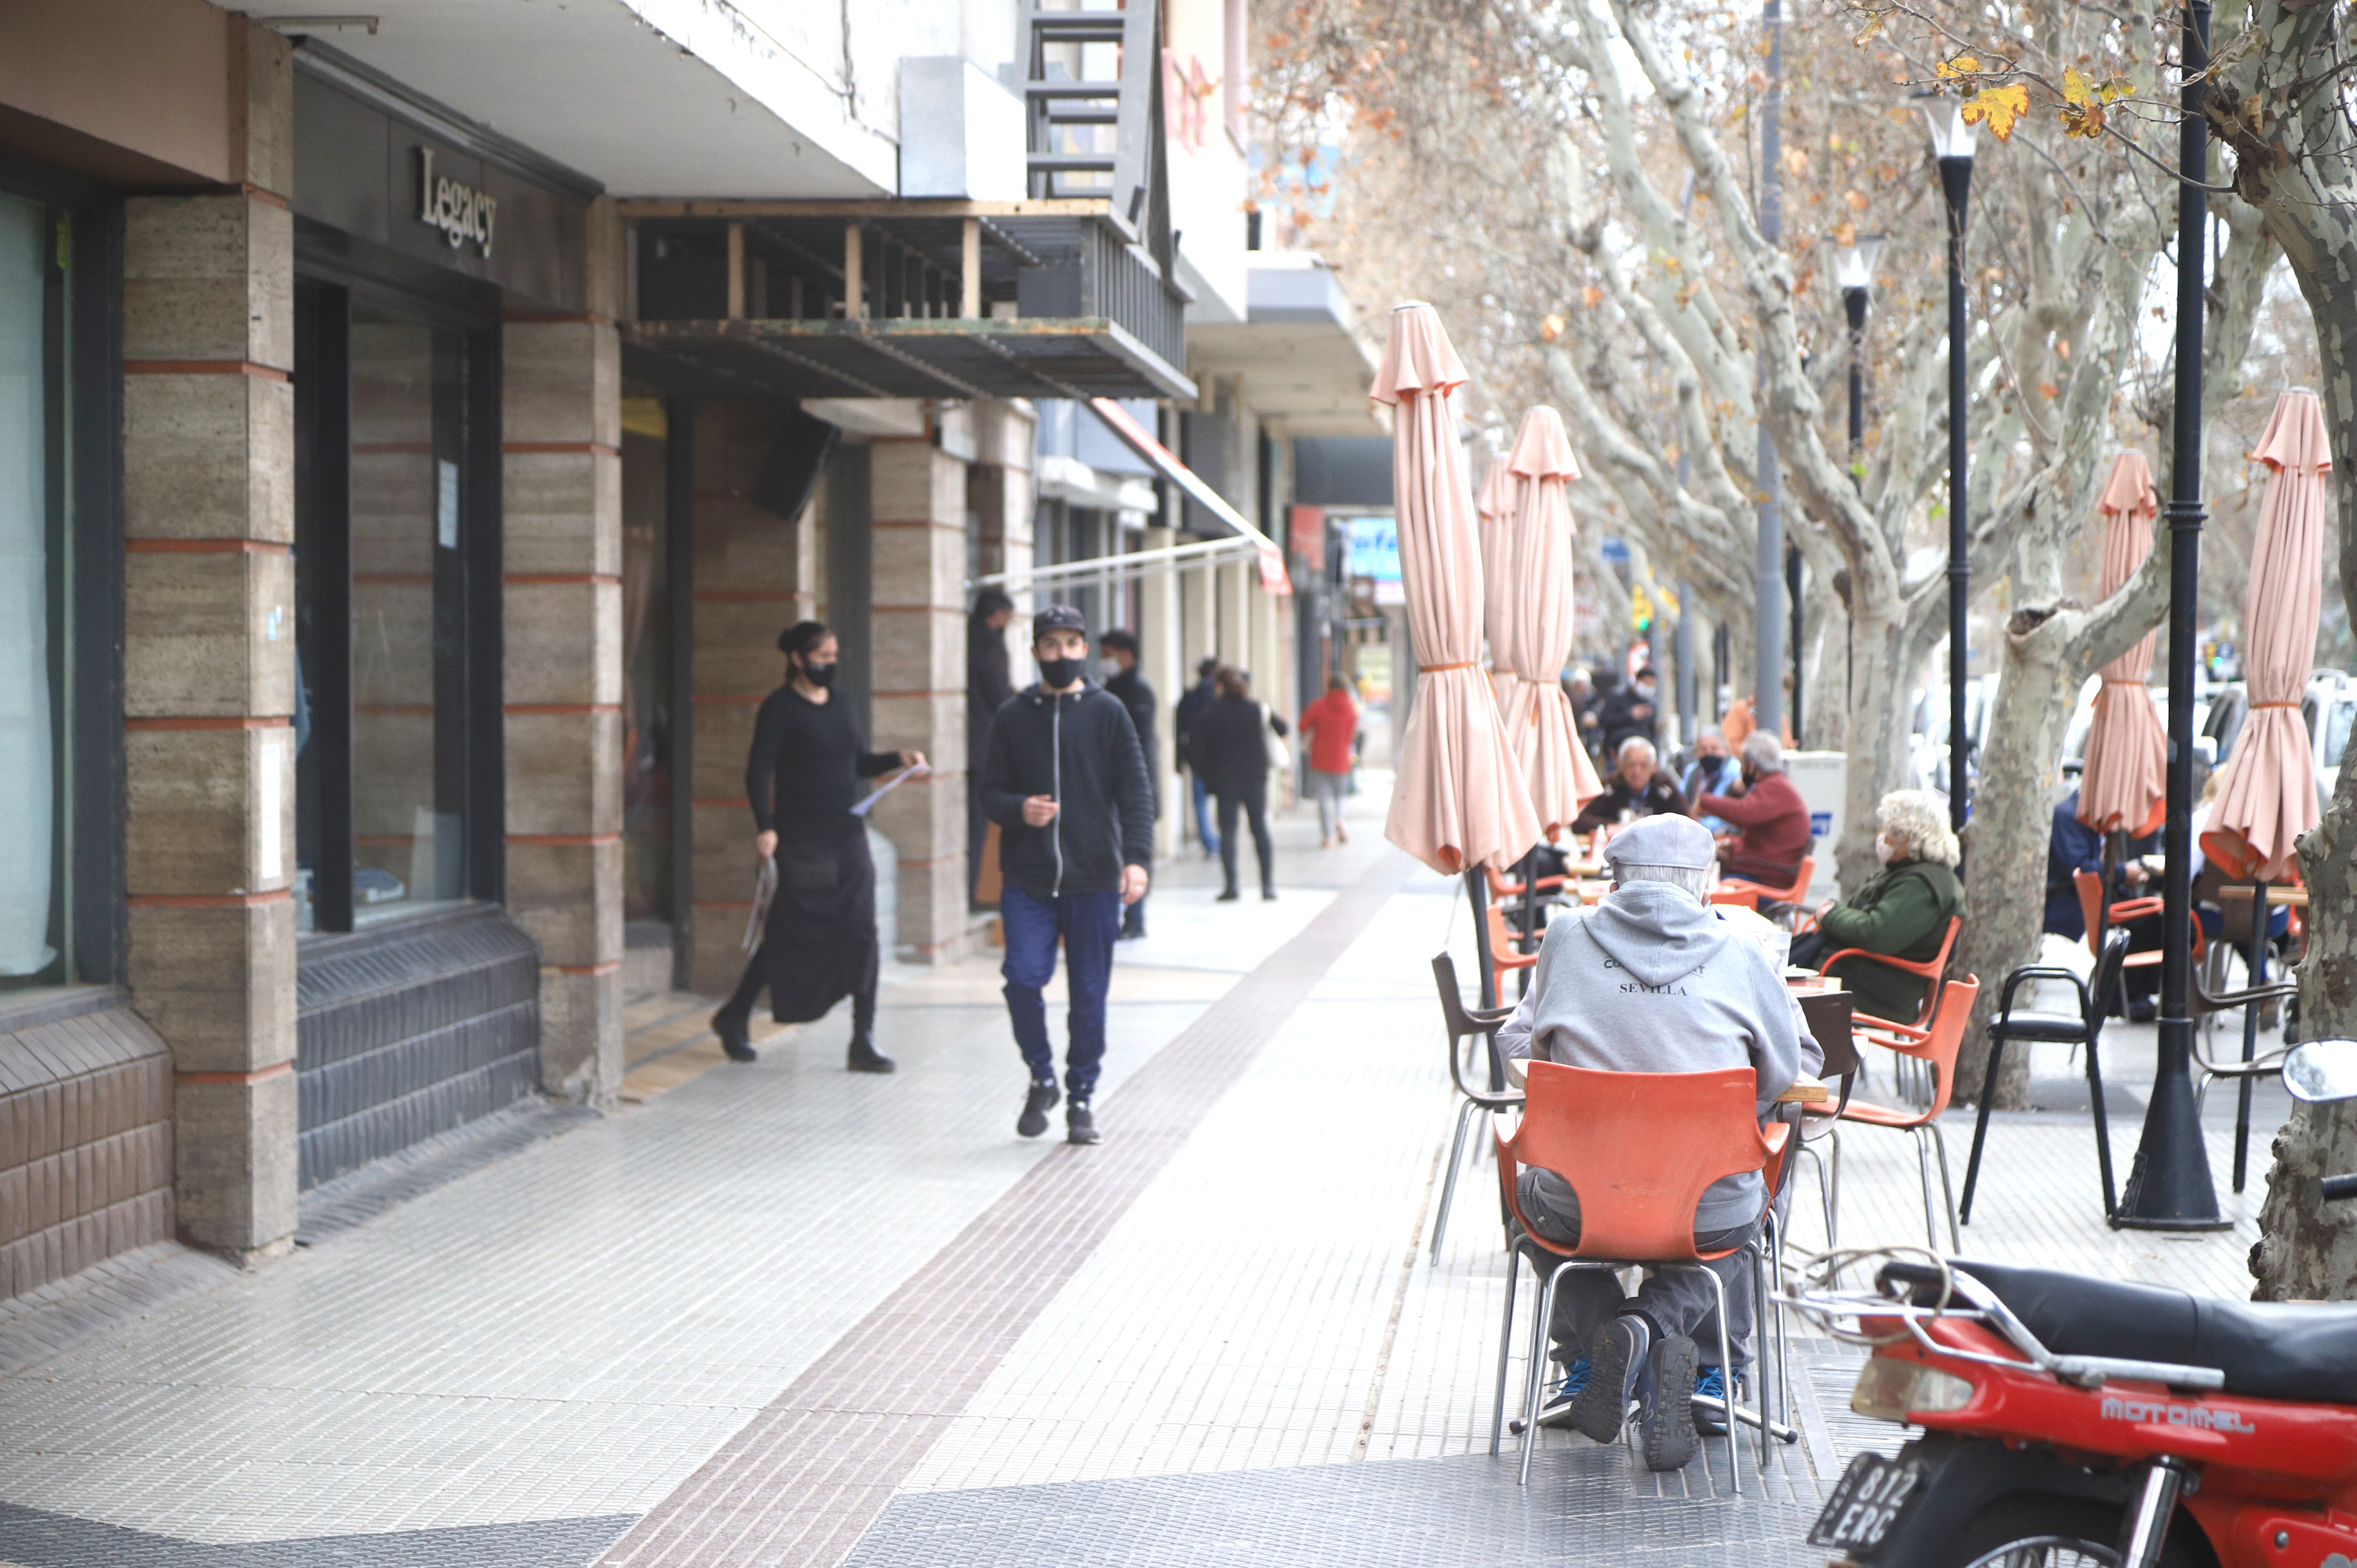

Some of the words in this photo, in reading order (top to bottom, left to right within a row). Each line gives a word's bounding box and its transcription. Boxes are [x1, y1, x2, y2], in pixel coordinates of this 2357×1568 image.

[422, 147, 497, 258] Legacy
[1620, 983, 1687, 996] SEVILLA
[2101, 1397, 2255, 1434] MOTOMEL
[1858, 1465, 1918, 1508] 812
